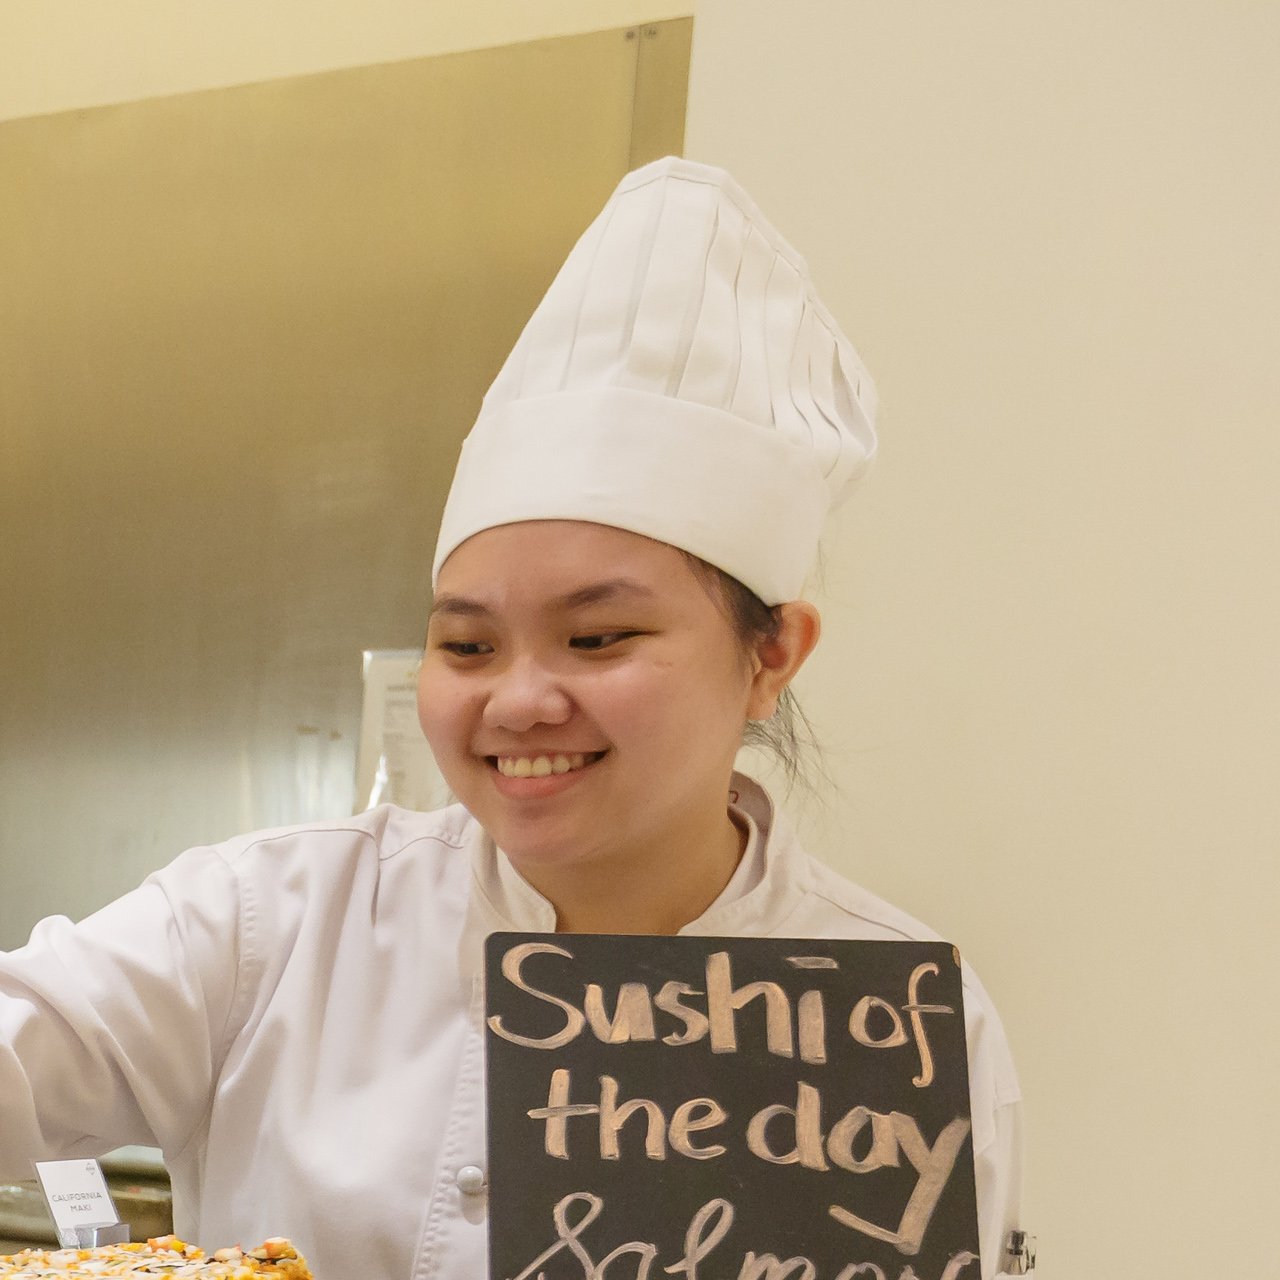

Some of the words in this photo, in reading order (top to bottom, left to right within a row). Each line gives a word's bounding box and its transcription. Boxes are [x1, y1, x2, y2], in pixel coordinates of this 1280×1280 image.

[487, 942, 839, 1065] Sushi
[849, 962, 954, 1088] of
[51, 1192, 102, 1202] CALIFORNIA
[527, 1068, 728, 1161] the
[745, 1080, 970, 1255] day
[70, 1204, 92, 1212] MAKI
